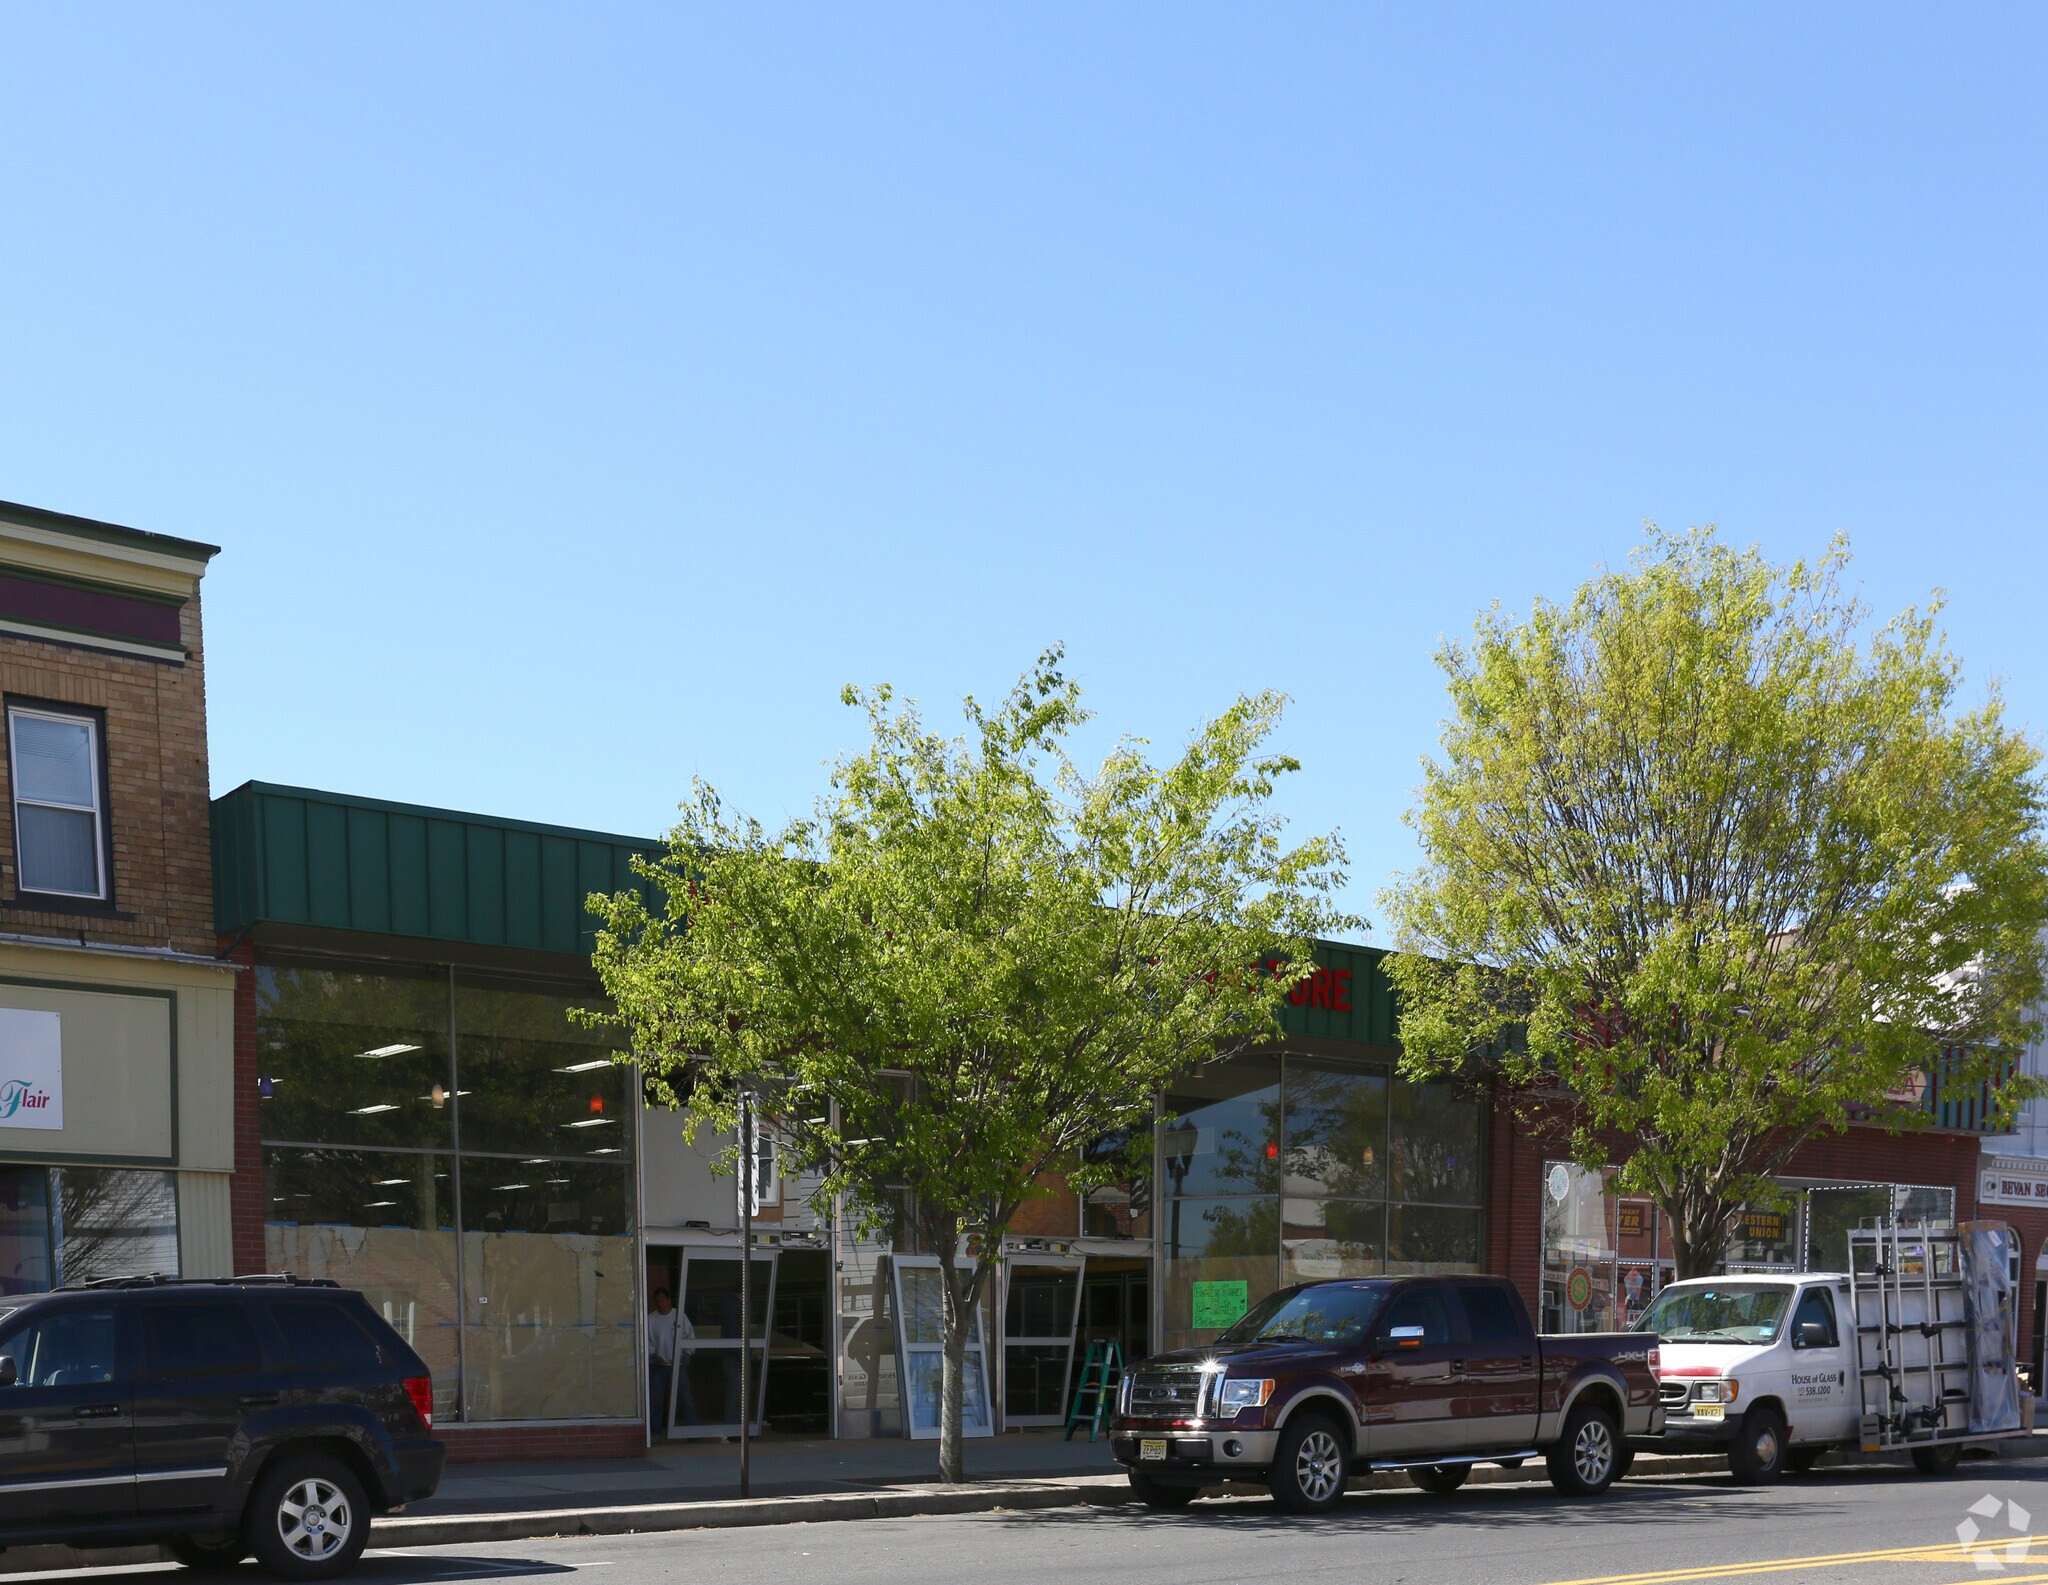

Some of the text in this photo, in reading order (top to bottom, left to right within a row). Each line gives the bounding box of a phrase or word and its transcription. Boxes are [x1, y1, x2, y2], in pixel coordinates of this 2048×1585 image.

[0, 1079, 50, 1118] Flair
[2001, 1180, 2031, 1196] BEVAN
[1749, 1226, 1779, 1239] UNION
